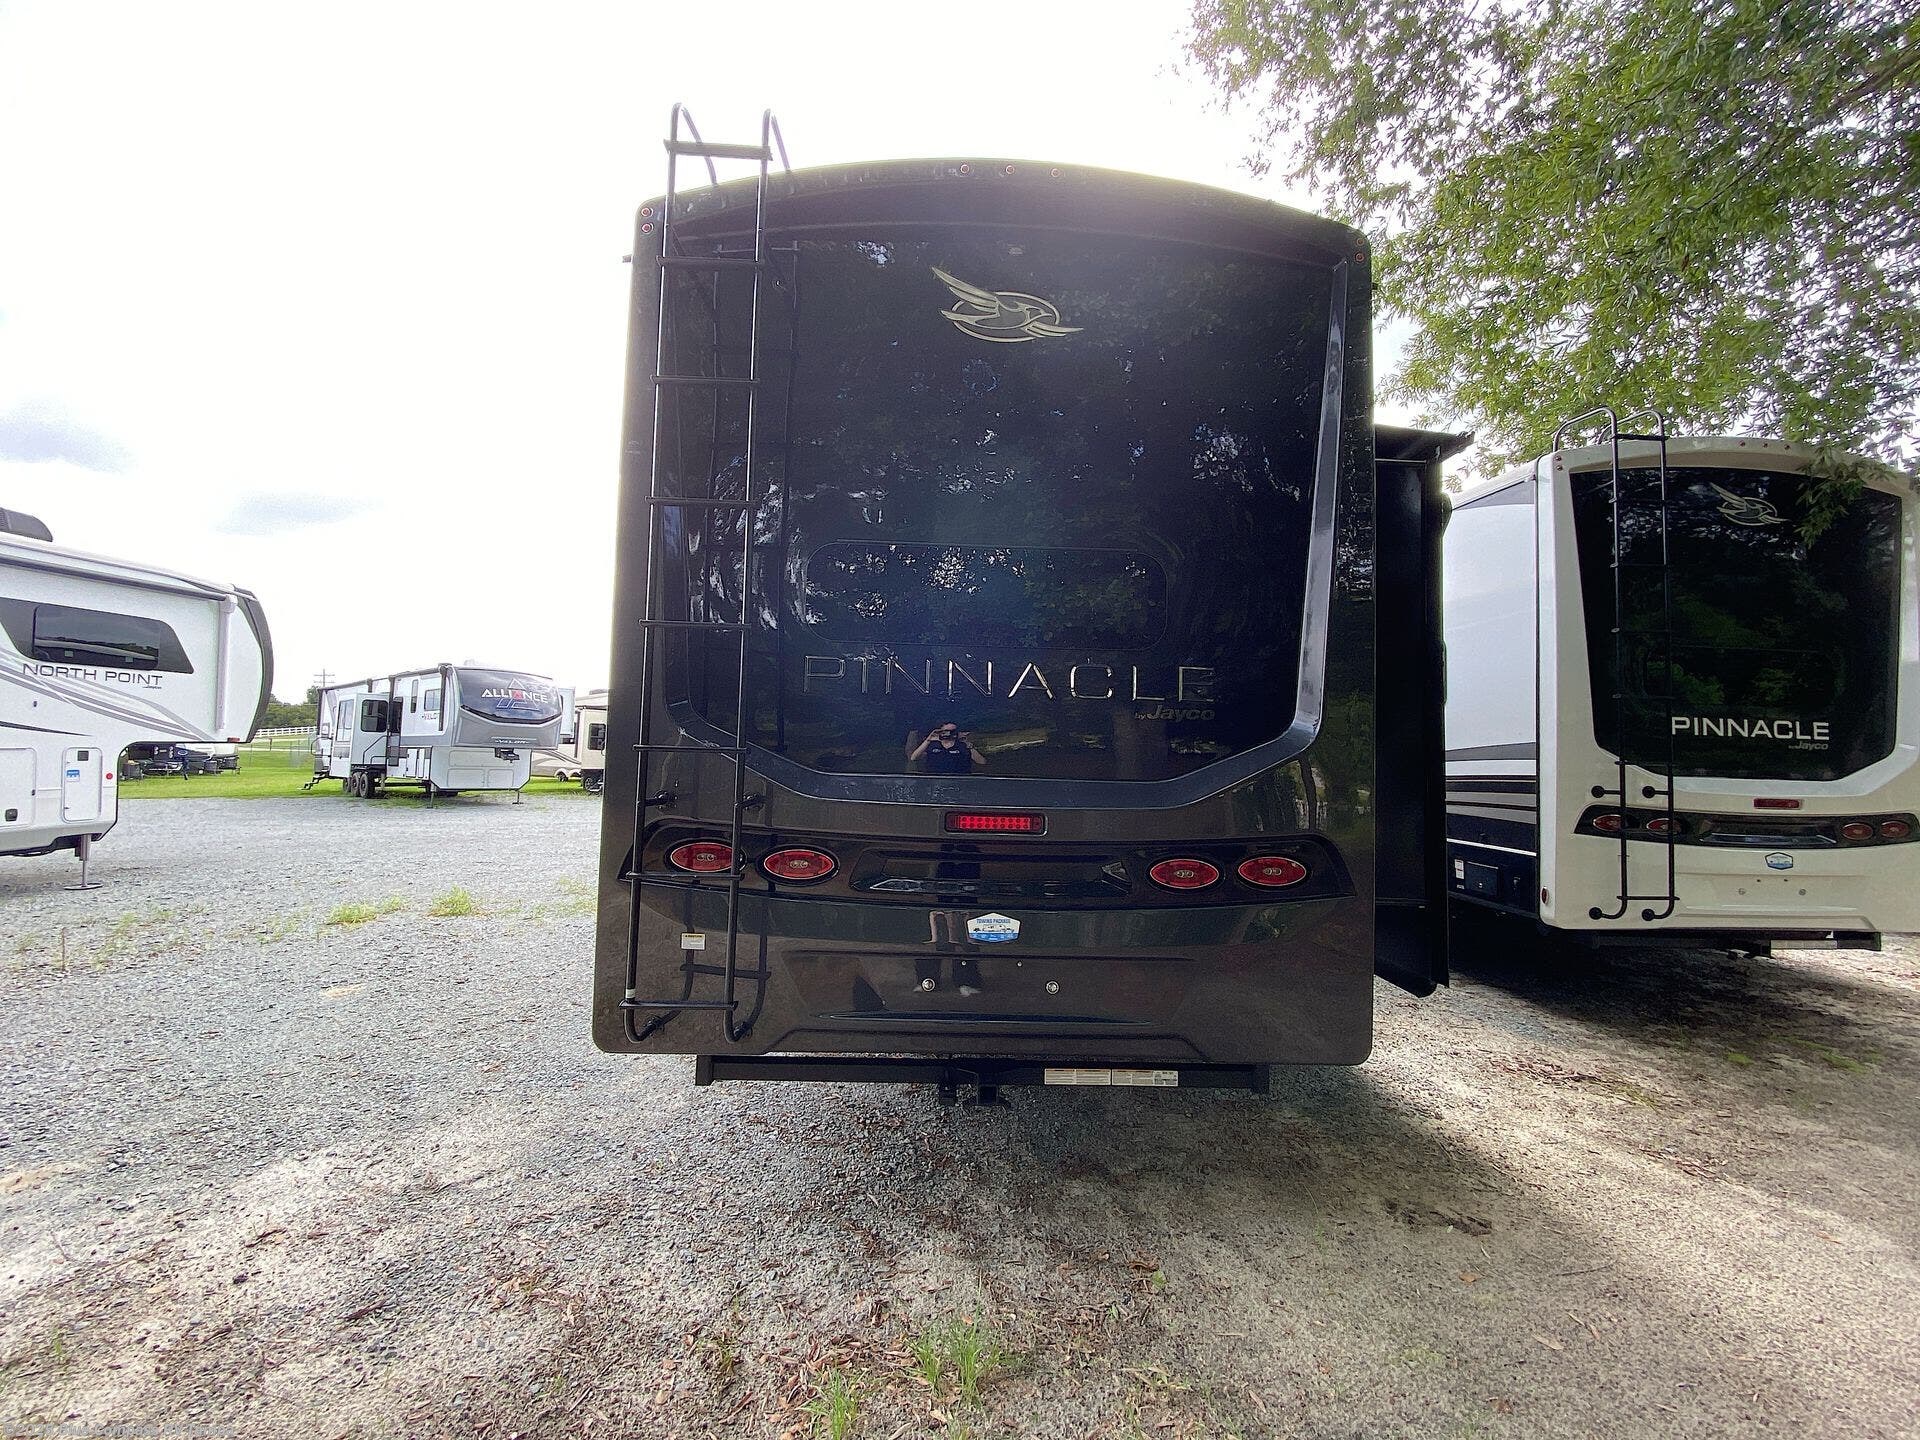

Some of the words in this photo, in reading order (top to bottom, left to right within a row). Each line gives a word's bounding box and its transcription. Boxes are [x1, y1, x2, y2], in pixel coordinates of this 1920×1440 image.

[22, 663, 97, 680] NORTH
[105, 671, 163, 686] POINT
[803, 654, 1215, 702] PINNACLE
[481, 688, 549, 704] ALLIANCE
[1147, 704, 1216, 722] Jayco
[1671, 716, 1830, 741] PINNACLE
[1795, 740, 1829, 751] Jayco
